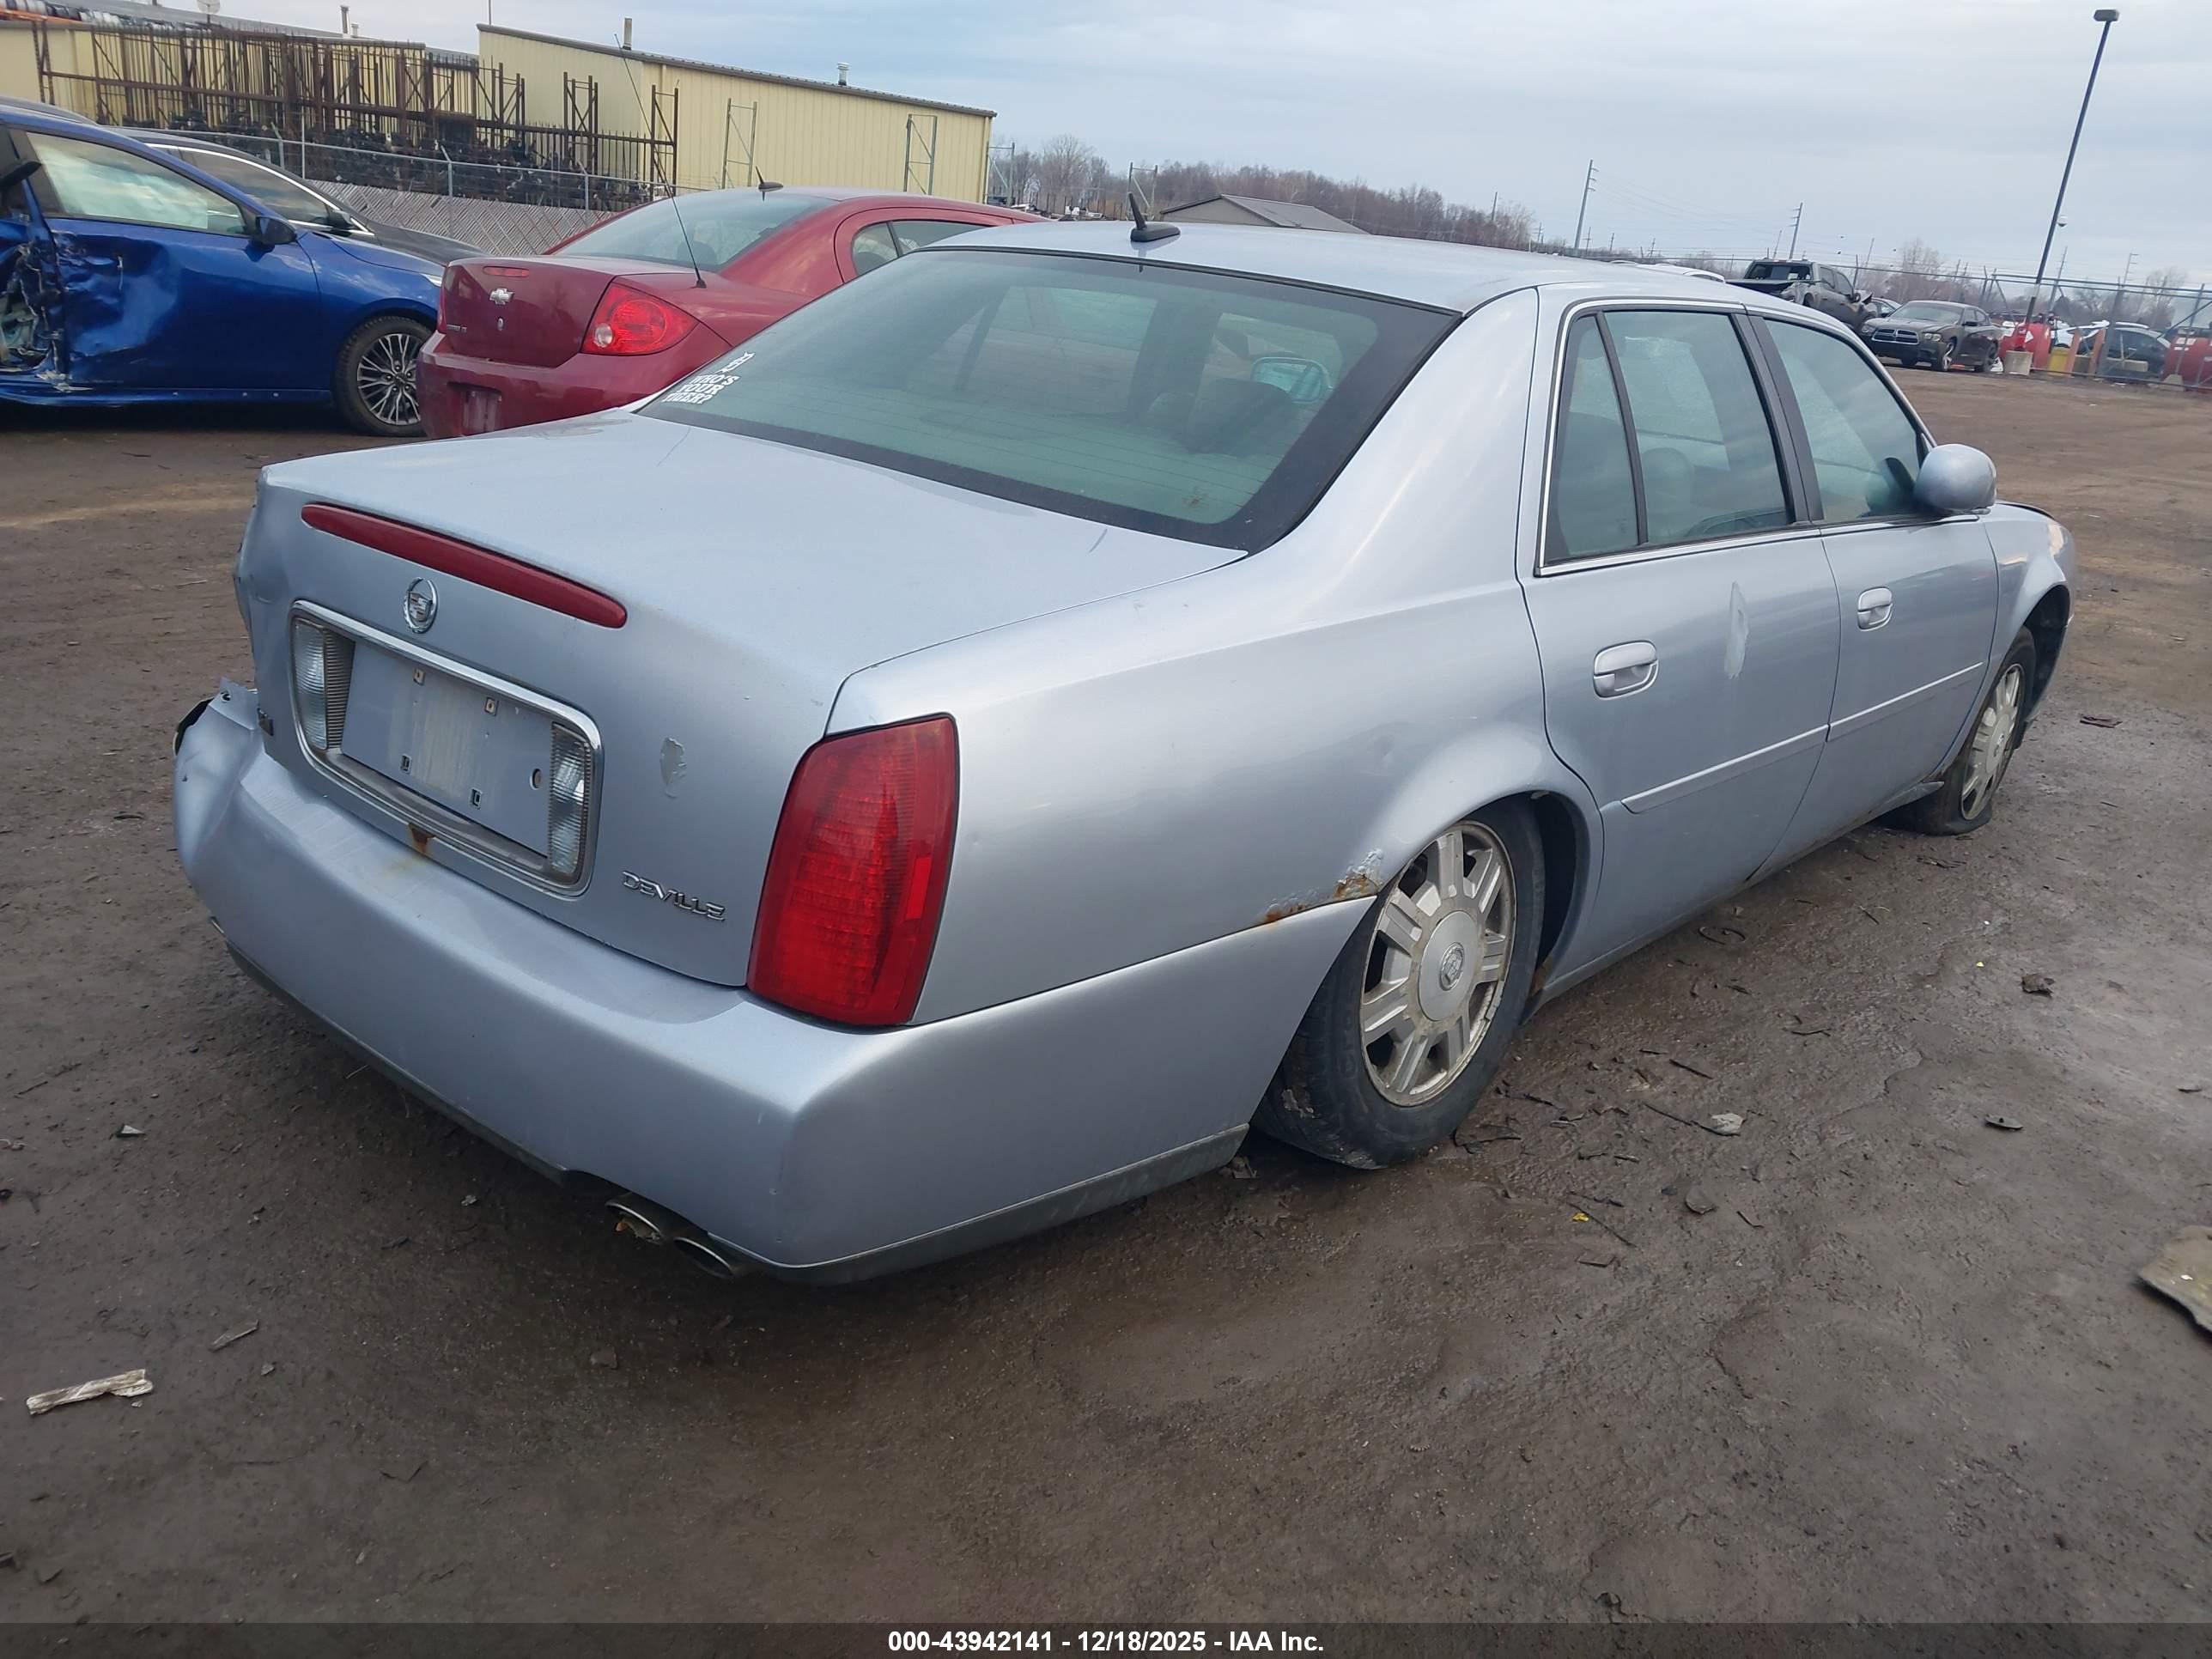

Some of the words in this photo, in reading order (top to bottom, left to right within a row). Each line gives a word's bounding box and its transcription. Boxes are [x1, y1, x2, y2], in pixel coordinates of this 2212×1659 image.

[690, 374, 740, 386] WHO'S
[677, 383, 724, 395] YOUR
[661, 392, 713, 404] TIGER?
[622, 870, 726, 921] DEVILLE
